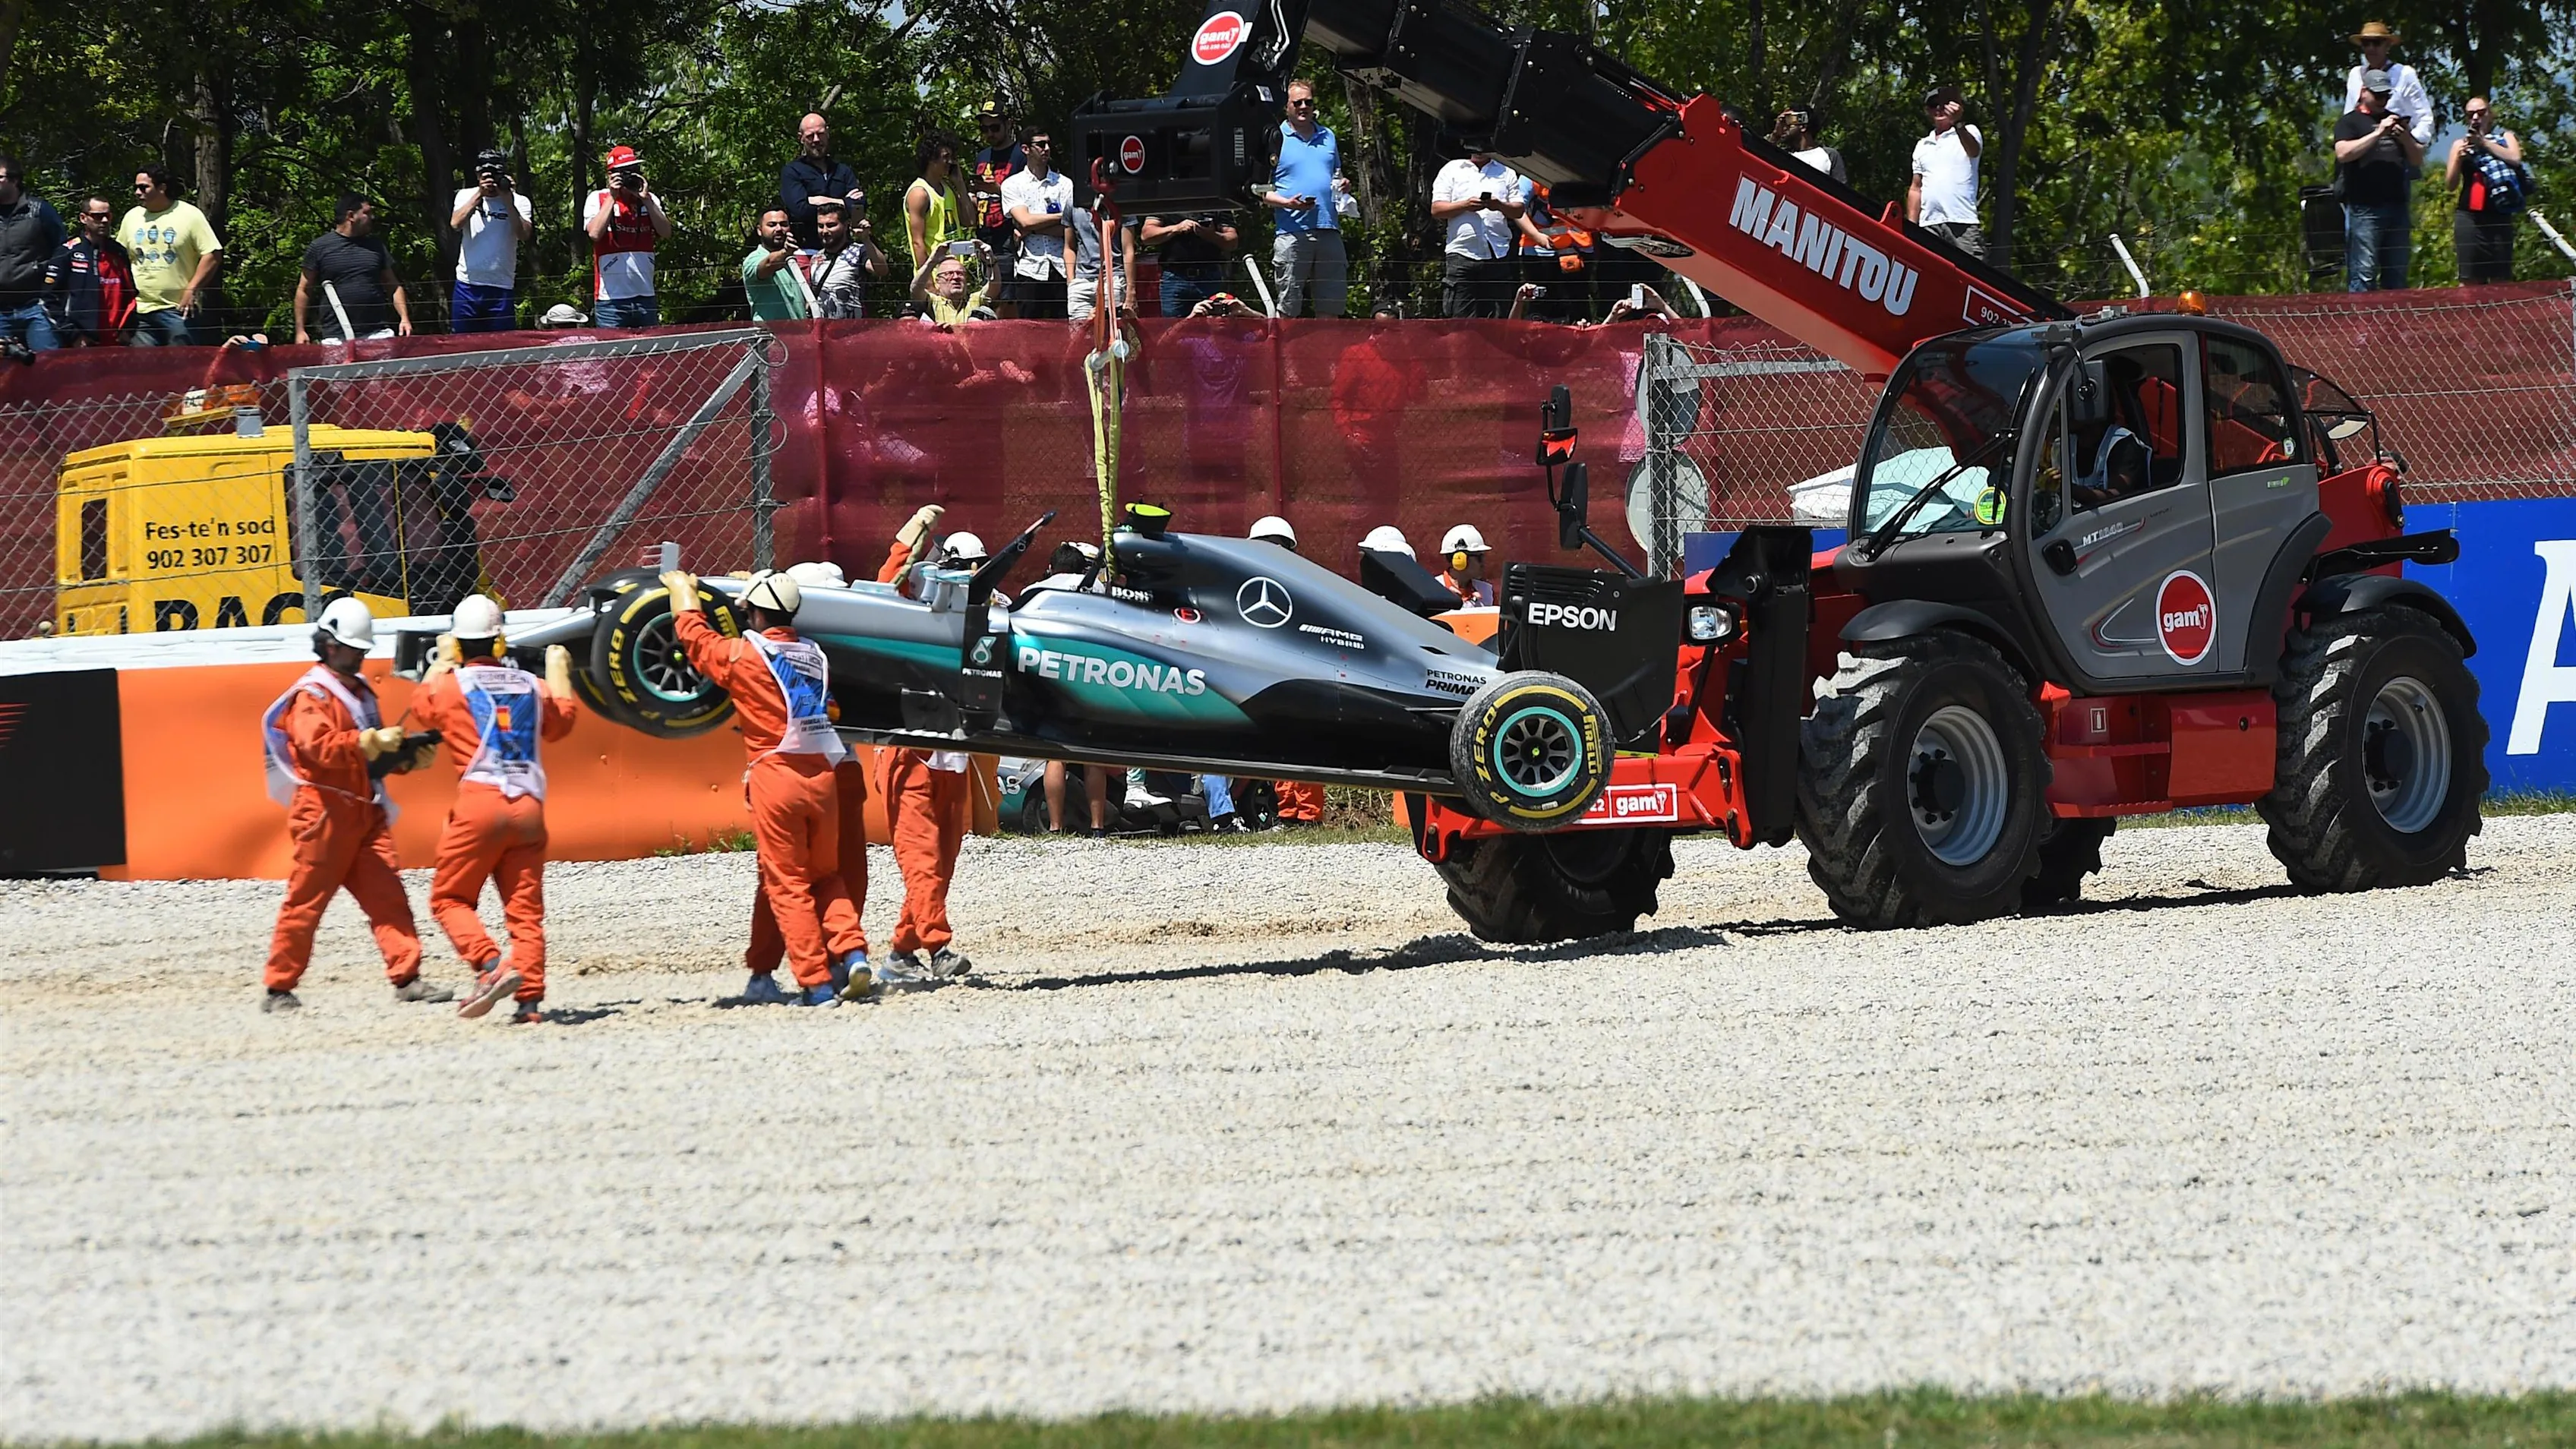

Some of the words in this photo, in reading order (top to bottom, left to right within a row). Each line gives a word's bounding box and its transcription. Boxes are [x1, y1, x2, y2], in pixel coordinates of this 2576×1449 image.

[1728, 175, 1919, 316] MANITOU
[147, 550, 184, 569] 902
[192, 547, 228, 566] 307
[236, 545, 272, 564] 307
[1528, 602, 1617, 631] EPSON
[1320, 636, 1365, 649] HYBRID
[608, 628, 638, 703] ZERO
[961, 667, 1002, 678] PETRONAS
[1018, 646, 1205, 696] PETRONAS
[1426, 669, 1487, 684] PETRONAS
[1425, 679, 1481, 696] PRIMA
[1473, 706, 1498, 782] ZERO
[1583, 715, 1602, 775] PIRELLI
